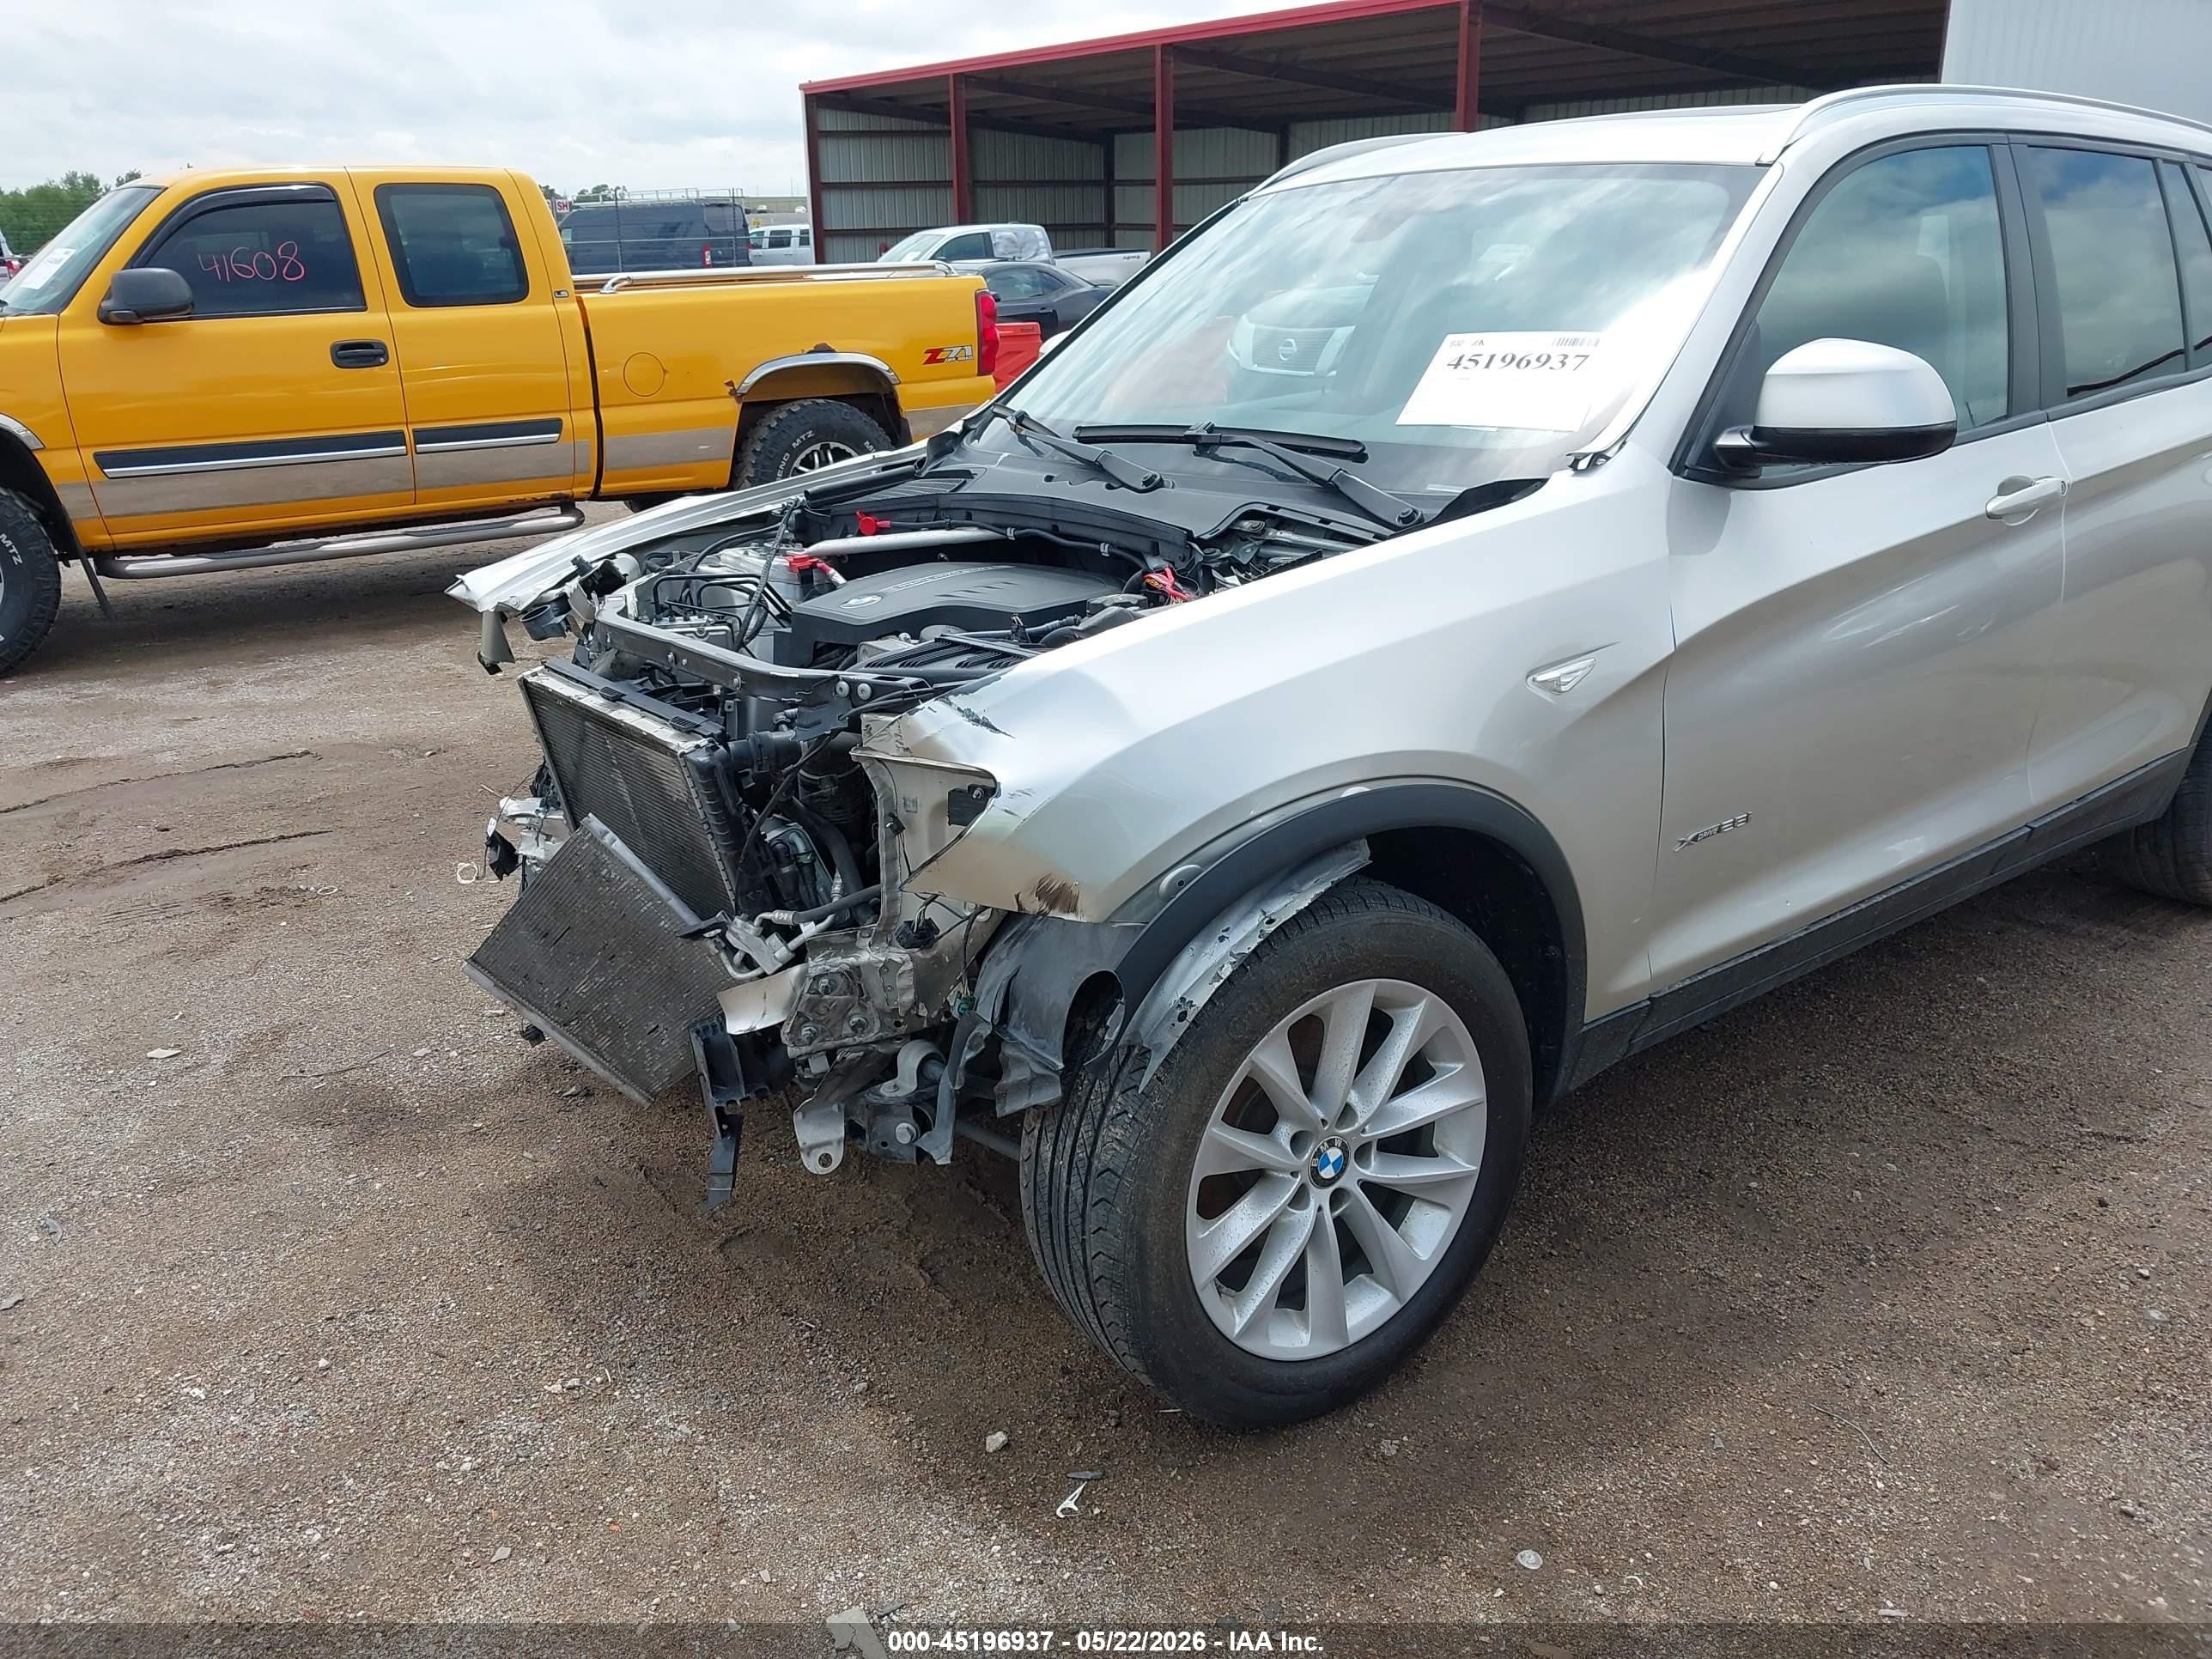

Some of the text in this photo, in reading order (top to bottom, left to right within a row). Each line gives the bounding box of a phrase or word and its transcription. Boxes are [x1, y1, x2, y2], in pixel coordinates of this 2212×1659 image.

[197, 240, 305, 282] 41608
[923, 345, 973, 365] Z71
[1447, 352, 1589, 371] 45196937
[0, 533, 23, 565] MTZ
[1311, 1138, 1343, 1167] BMW
